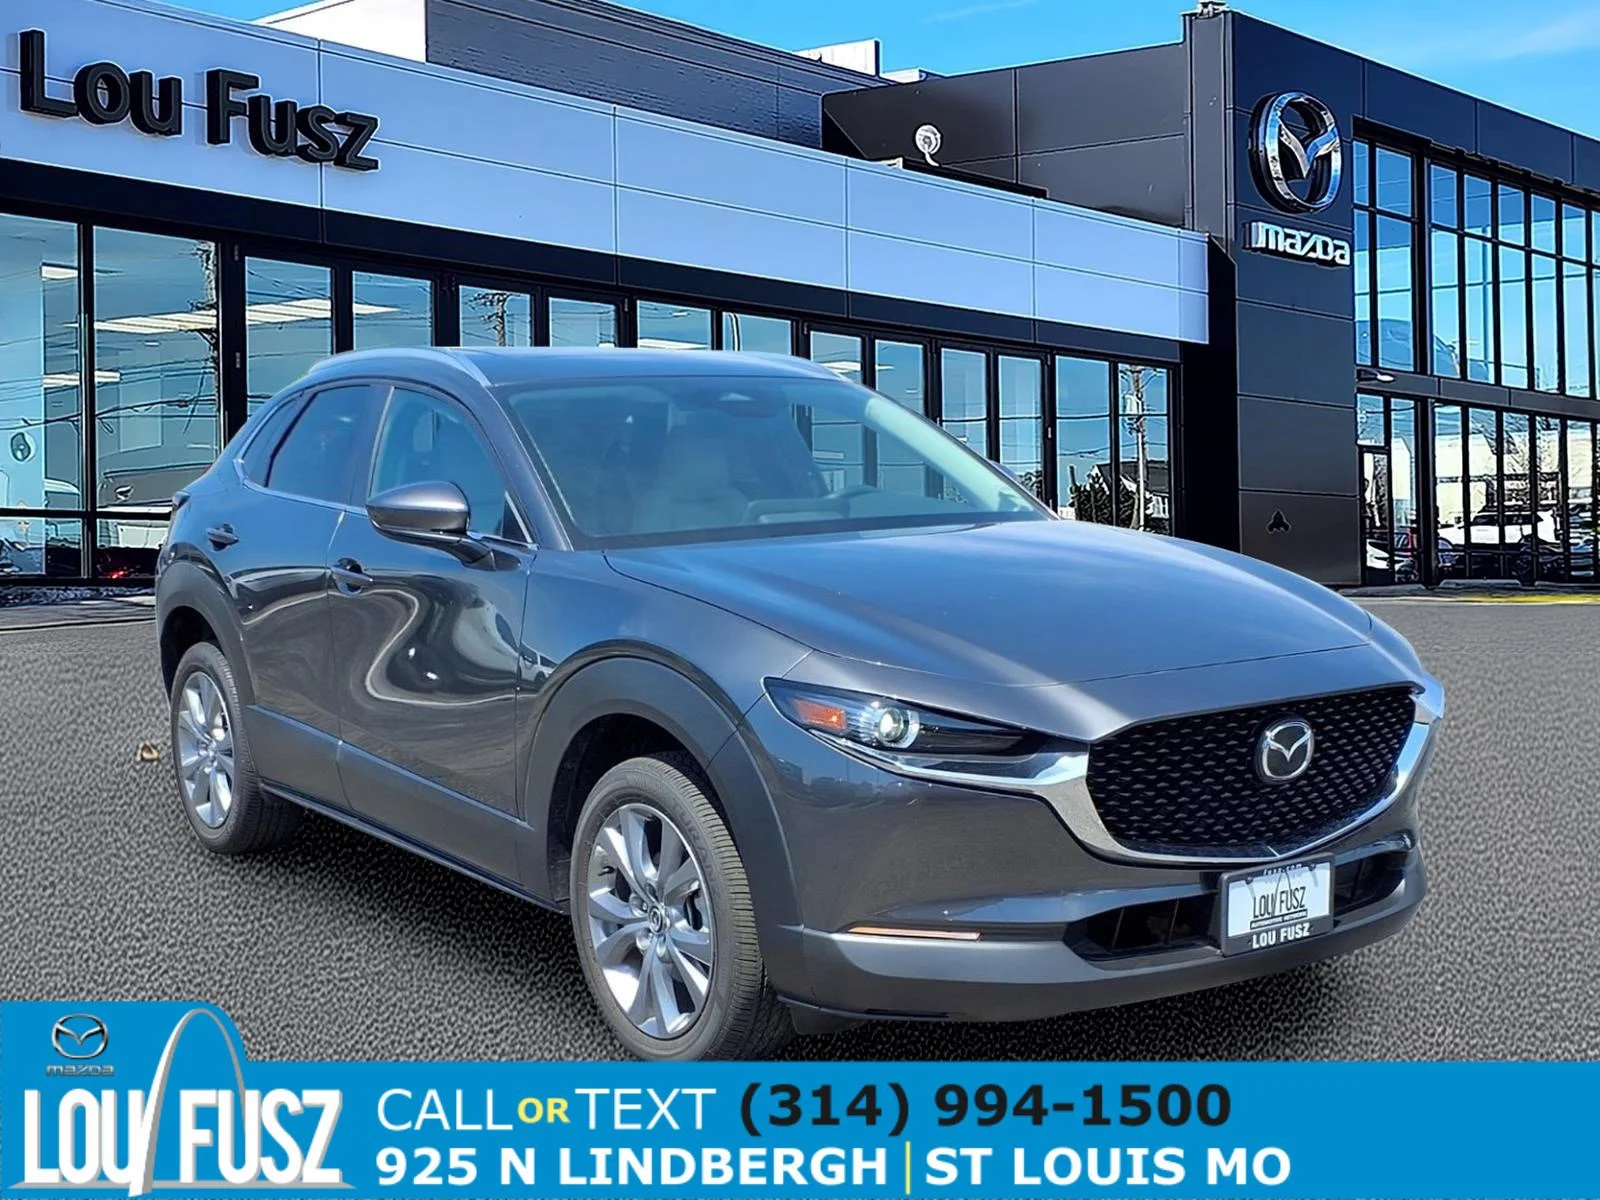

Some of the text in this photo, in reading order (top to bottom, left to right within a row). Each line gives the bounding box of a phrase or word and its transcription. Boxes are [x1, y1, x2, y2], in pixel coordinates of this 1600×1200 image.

[19, 29, 380, 172] Lou Fusz
[1252, 886, 1307, 919] LOU FUSZ
[1252, 922, 1310, 949] LOU FUSZ
